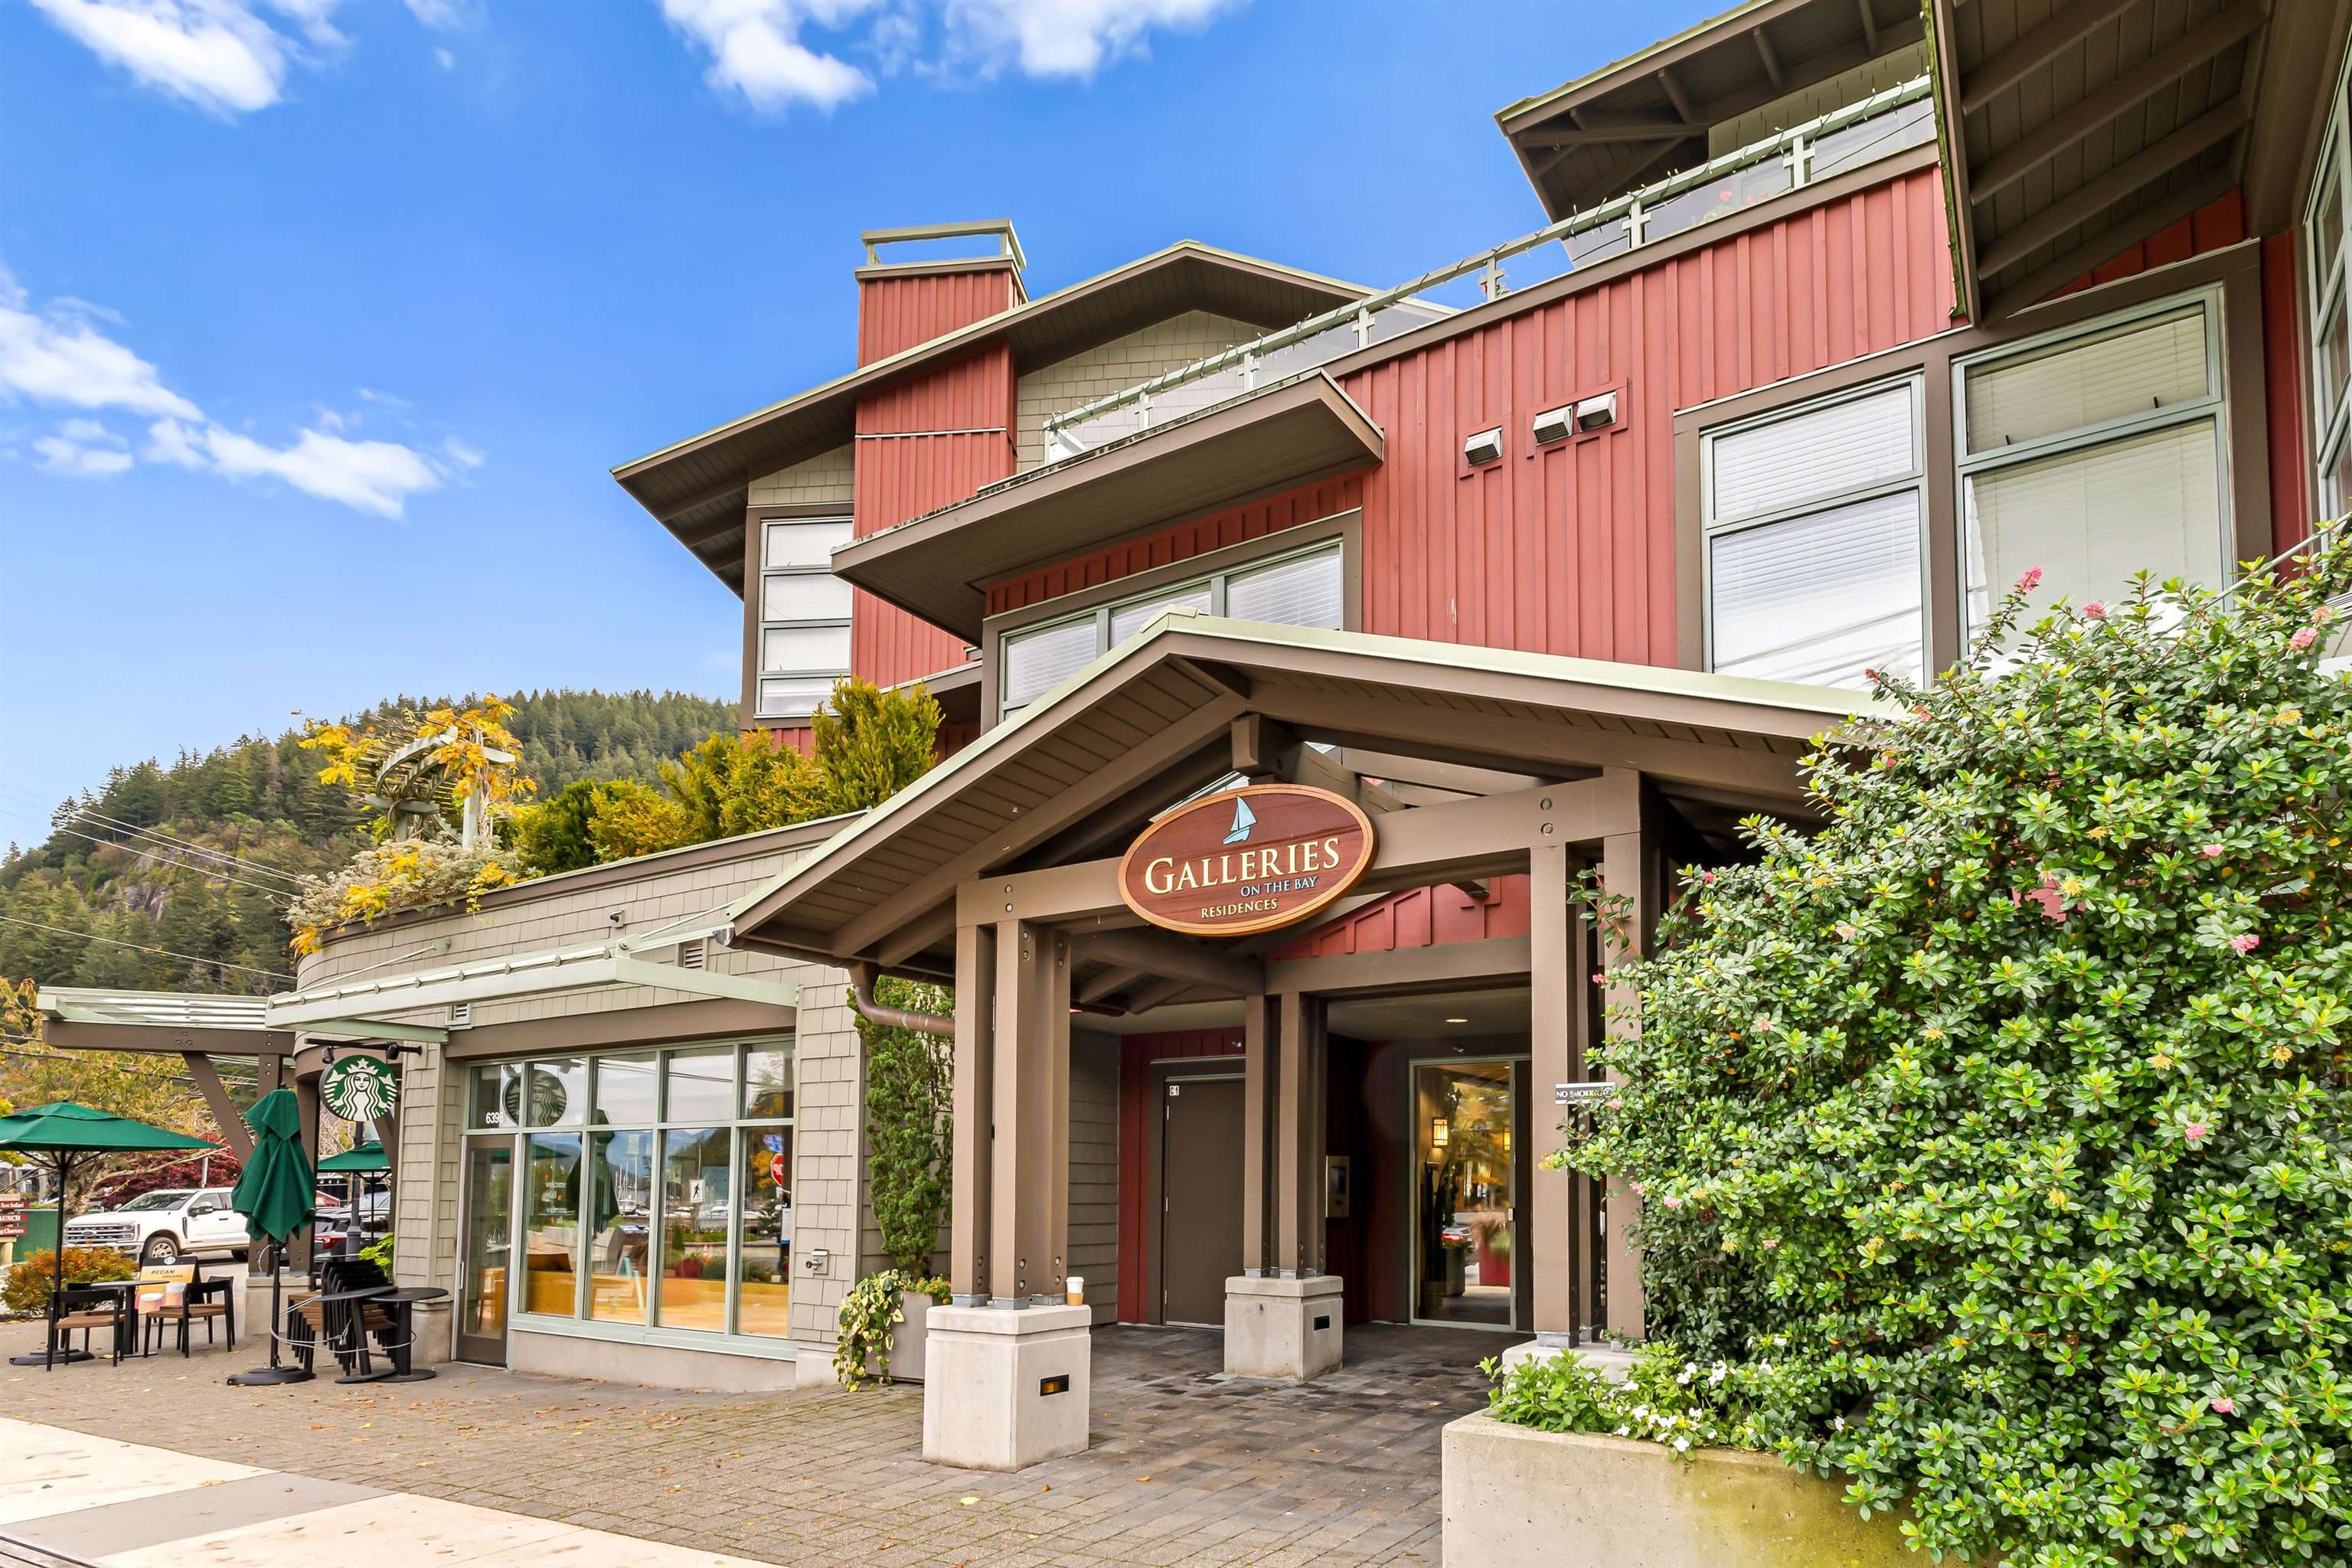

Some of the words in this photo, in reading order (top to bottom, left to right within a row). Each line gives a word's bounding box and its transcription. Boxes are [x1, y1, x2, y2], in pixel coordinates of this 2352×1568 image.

[1145, 838, 1341, 895] GALLERIES
[1240, 884, 1261, 898] ON
[1264, 880, 1291, 894] THE
[1294, 875, 1318, 890] BAY
[1200, 898, 1279, 919] RESIDENCES
[485, 1112, 504, 1124] 6398
